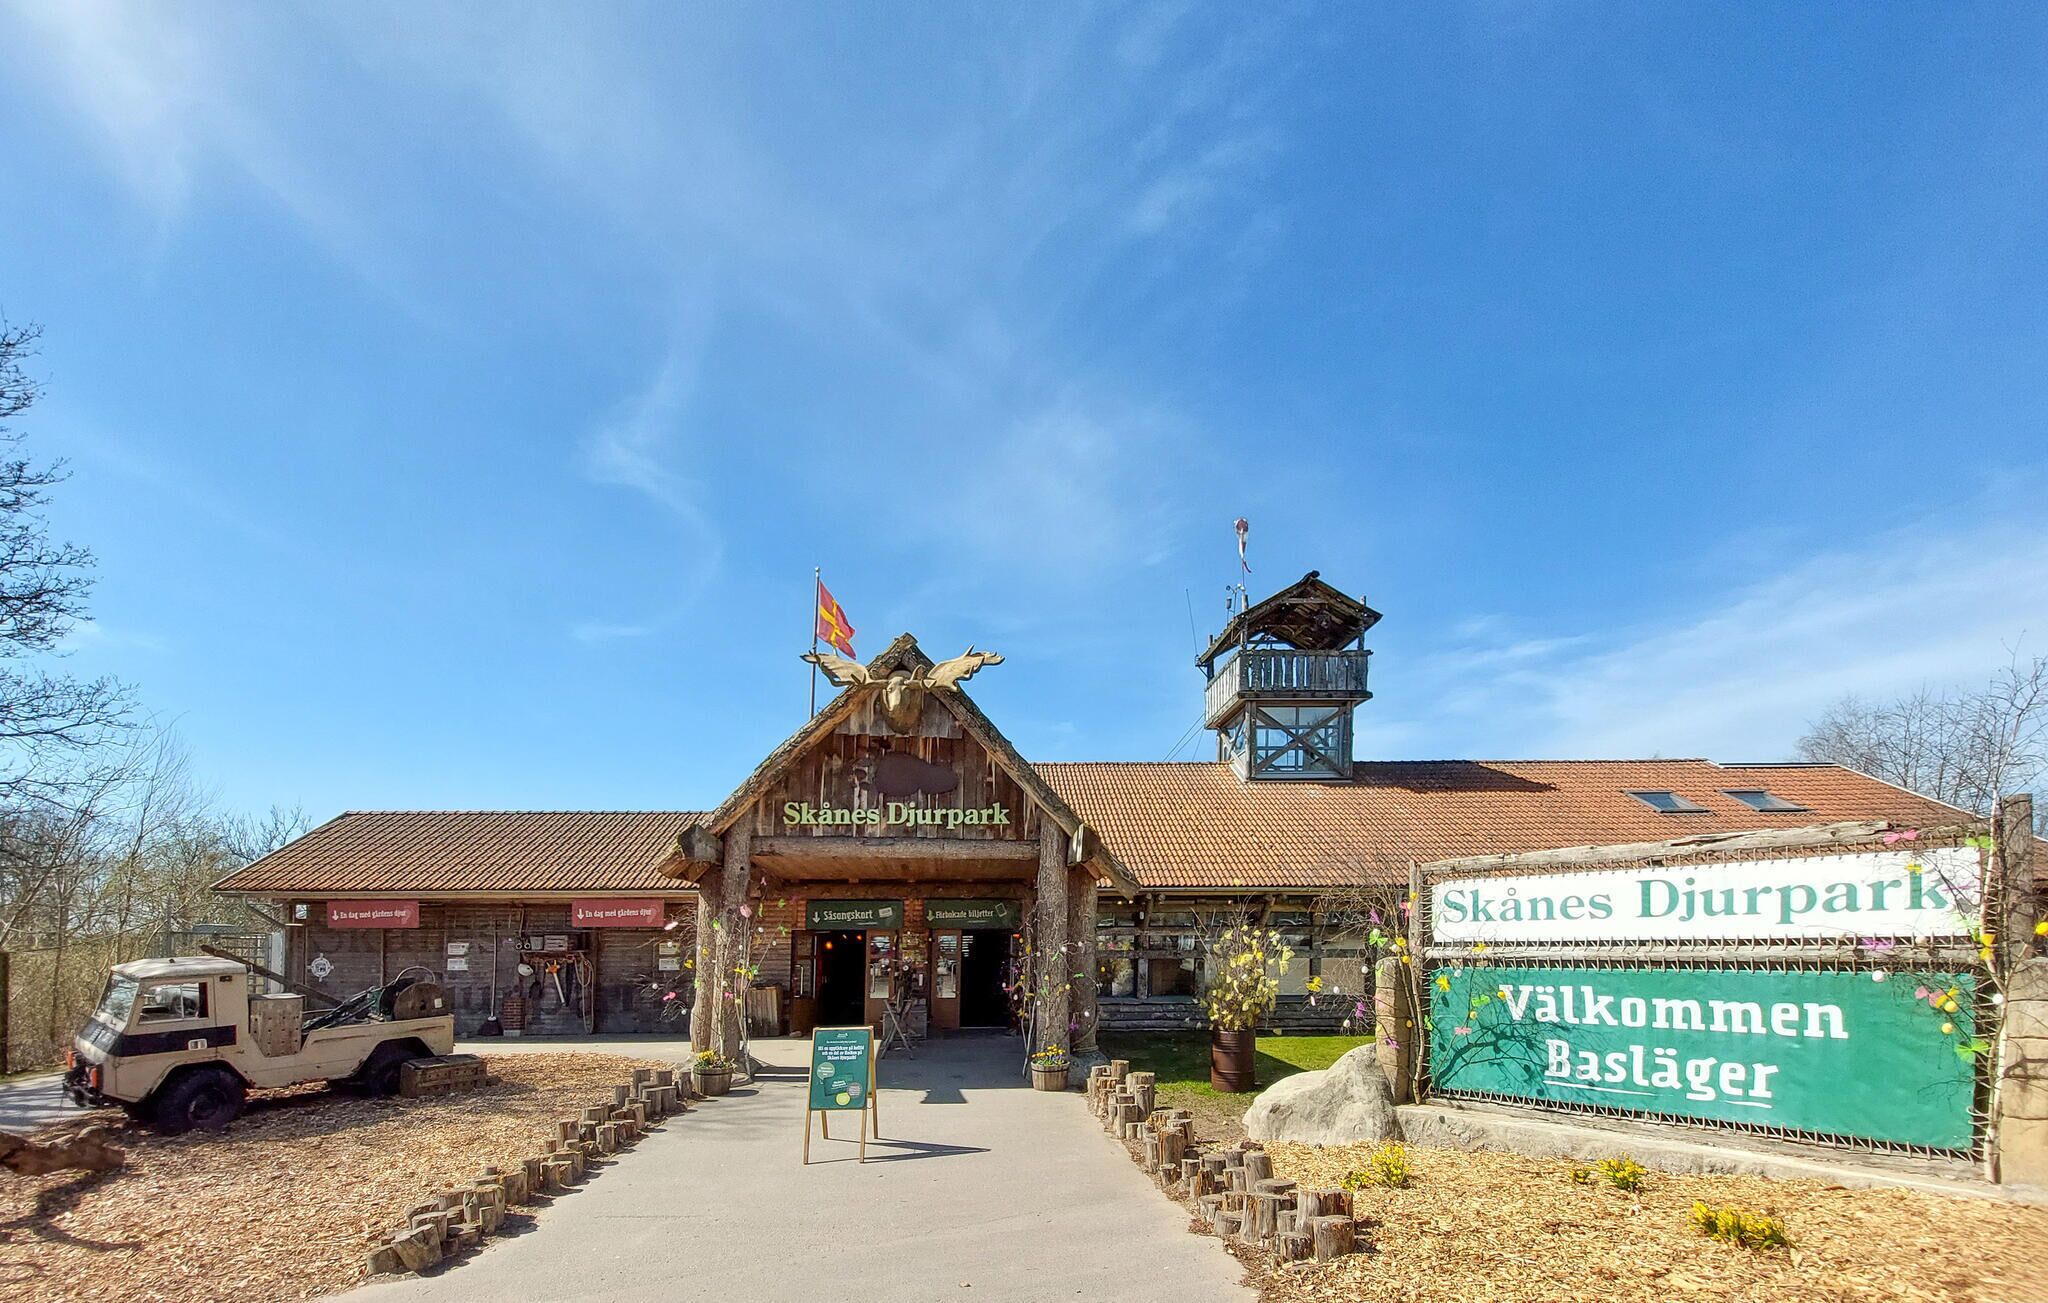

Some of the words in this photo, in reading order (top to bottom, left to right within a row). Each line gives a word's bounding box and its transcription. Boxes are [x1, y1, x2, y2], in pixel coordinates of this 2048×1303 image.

[783, 801, 880, 826] Skånes
[886, 802, 1010, 829] Djurpark
[1442, 888, 1613, 925] Skånes
[1636, 864, 1949, 925] Djurpark
[340, 911, 347, 919] En
[348, 911, 358, 920] dag
[585, 910, 593, 918] En
[594, 910, 603, 919] dag
[605, 909, 616, 917] med
[823, 909, 873, 922] Säsongskort
[935, 910, 967, 919] Förbokade
[968, 909, 994, 919] biljetter
[1498, 984, 1850, 1040] Välkommen
[1544, 1038, 1780, 1102] Basläger
